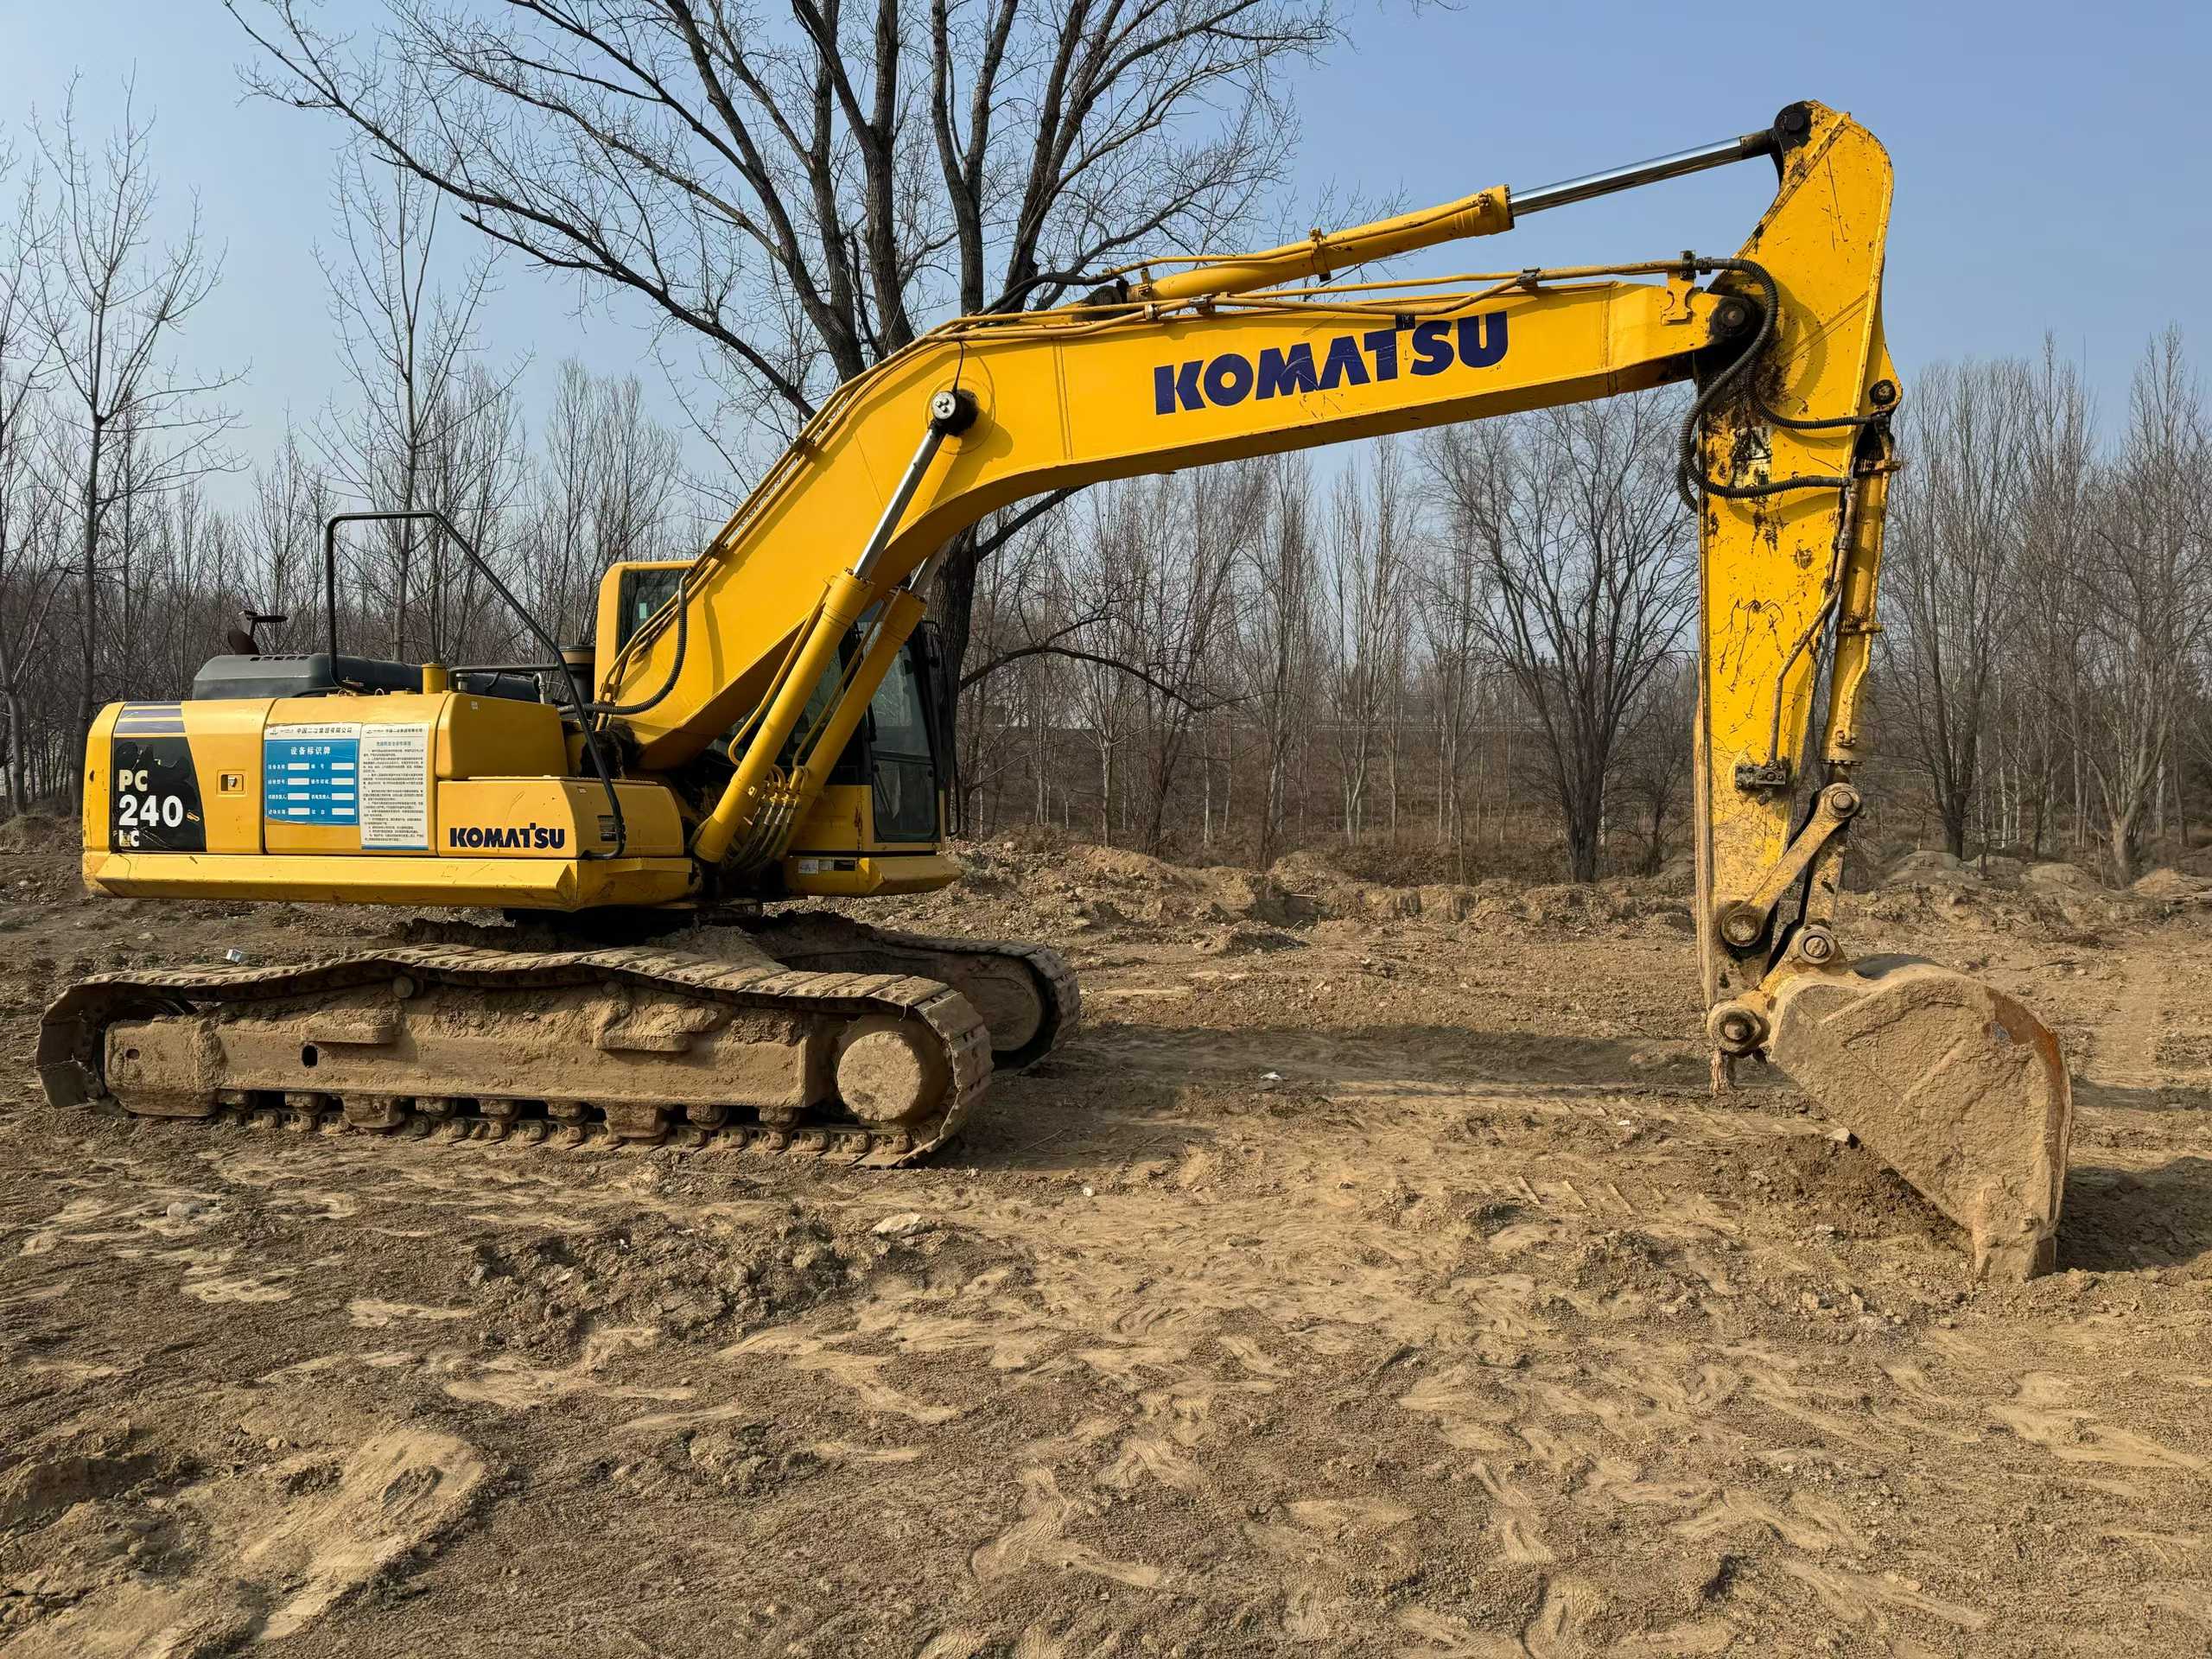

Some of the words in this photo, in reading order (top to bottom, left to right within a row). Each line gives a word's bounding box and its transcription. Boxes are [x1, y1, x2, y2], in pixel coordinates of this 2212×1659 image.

[1154, 310, 1509, 416] KOMATSU
[290, 746, 331, 755] 设备标识牌
[118, 769, 149, 792] PC
[118, 794, 183, 828] 240
[449, 822, 565, 849] KOMATSU
